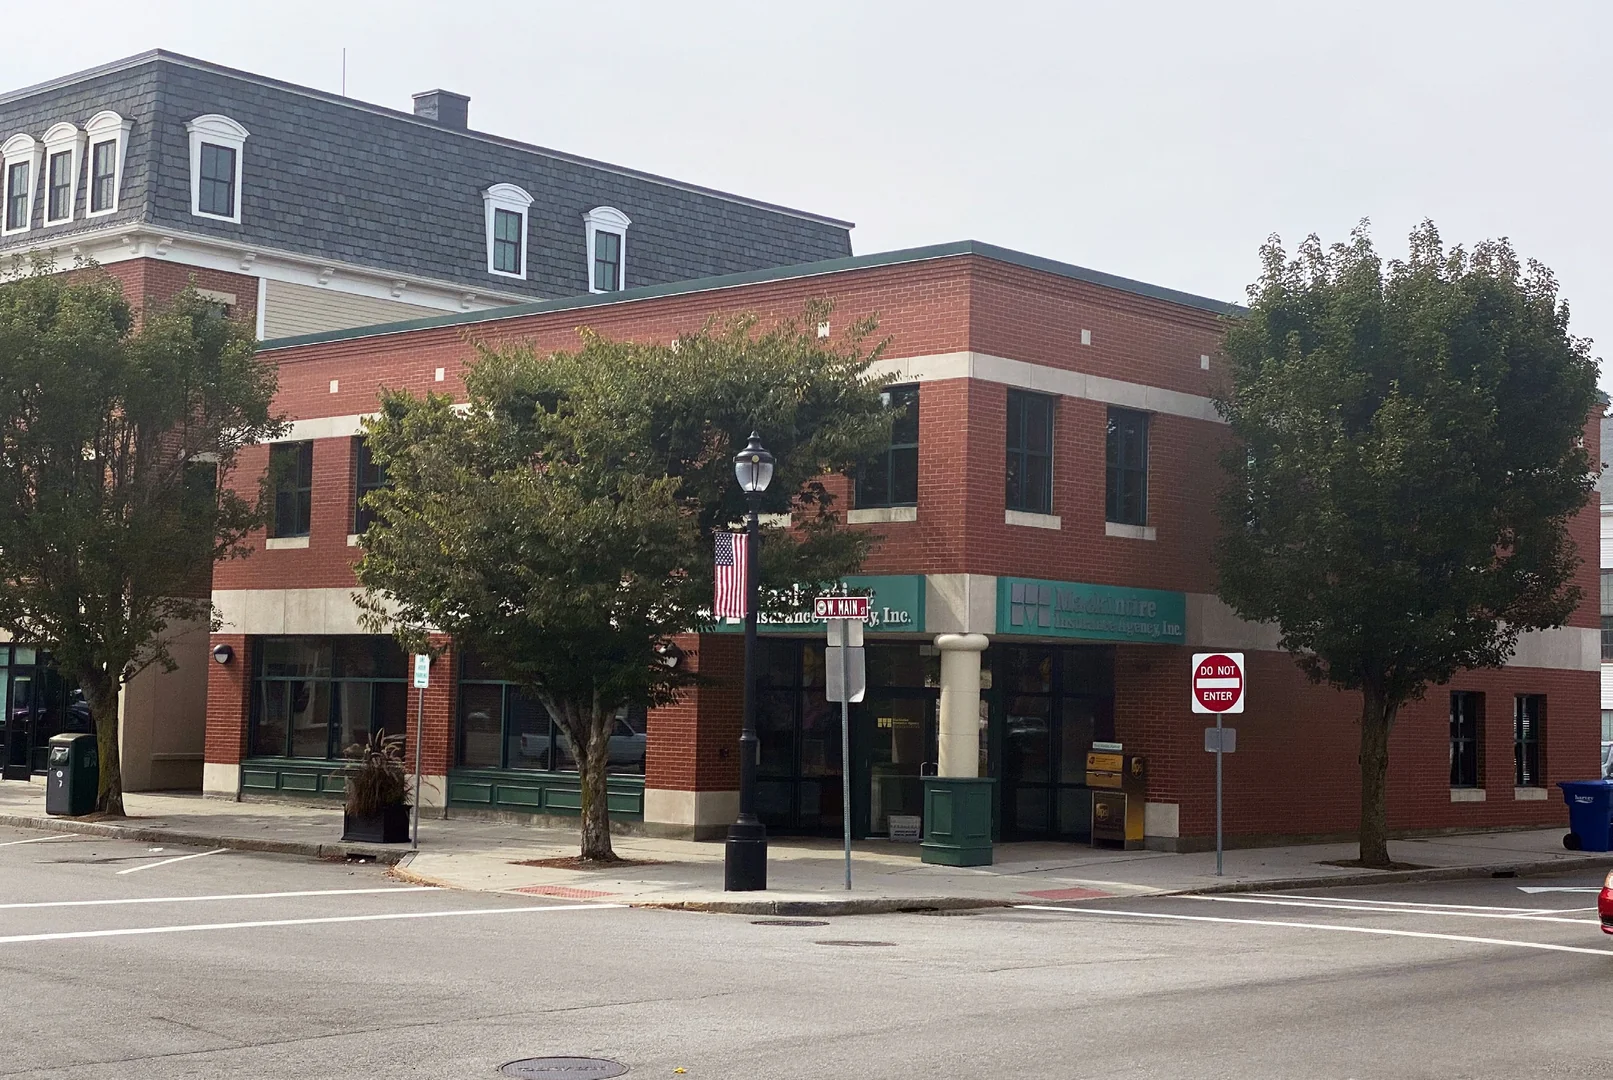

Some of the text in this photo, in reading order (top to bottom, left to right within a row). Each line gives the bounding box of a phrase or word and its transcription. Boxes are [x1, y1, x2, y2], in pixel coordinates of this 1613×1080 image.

[827, 600, 836, 615] W.
[838, 600, 858, 615] MAIN
[1055, 587, 1157, 618] Mackintire
[883, 607, 912, 623] Inc.
[1054, 612, 1117, 632] Insurance
[1163, 620, 1183, 635] Inc.
[1201, 666, 1235, 676] DO NOT
[1203, 692, 1233, 700] ENTER
